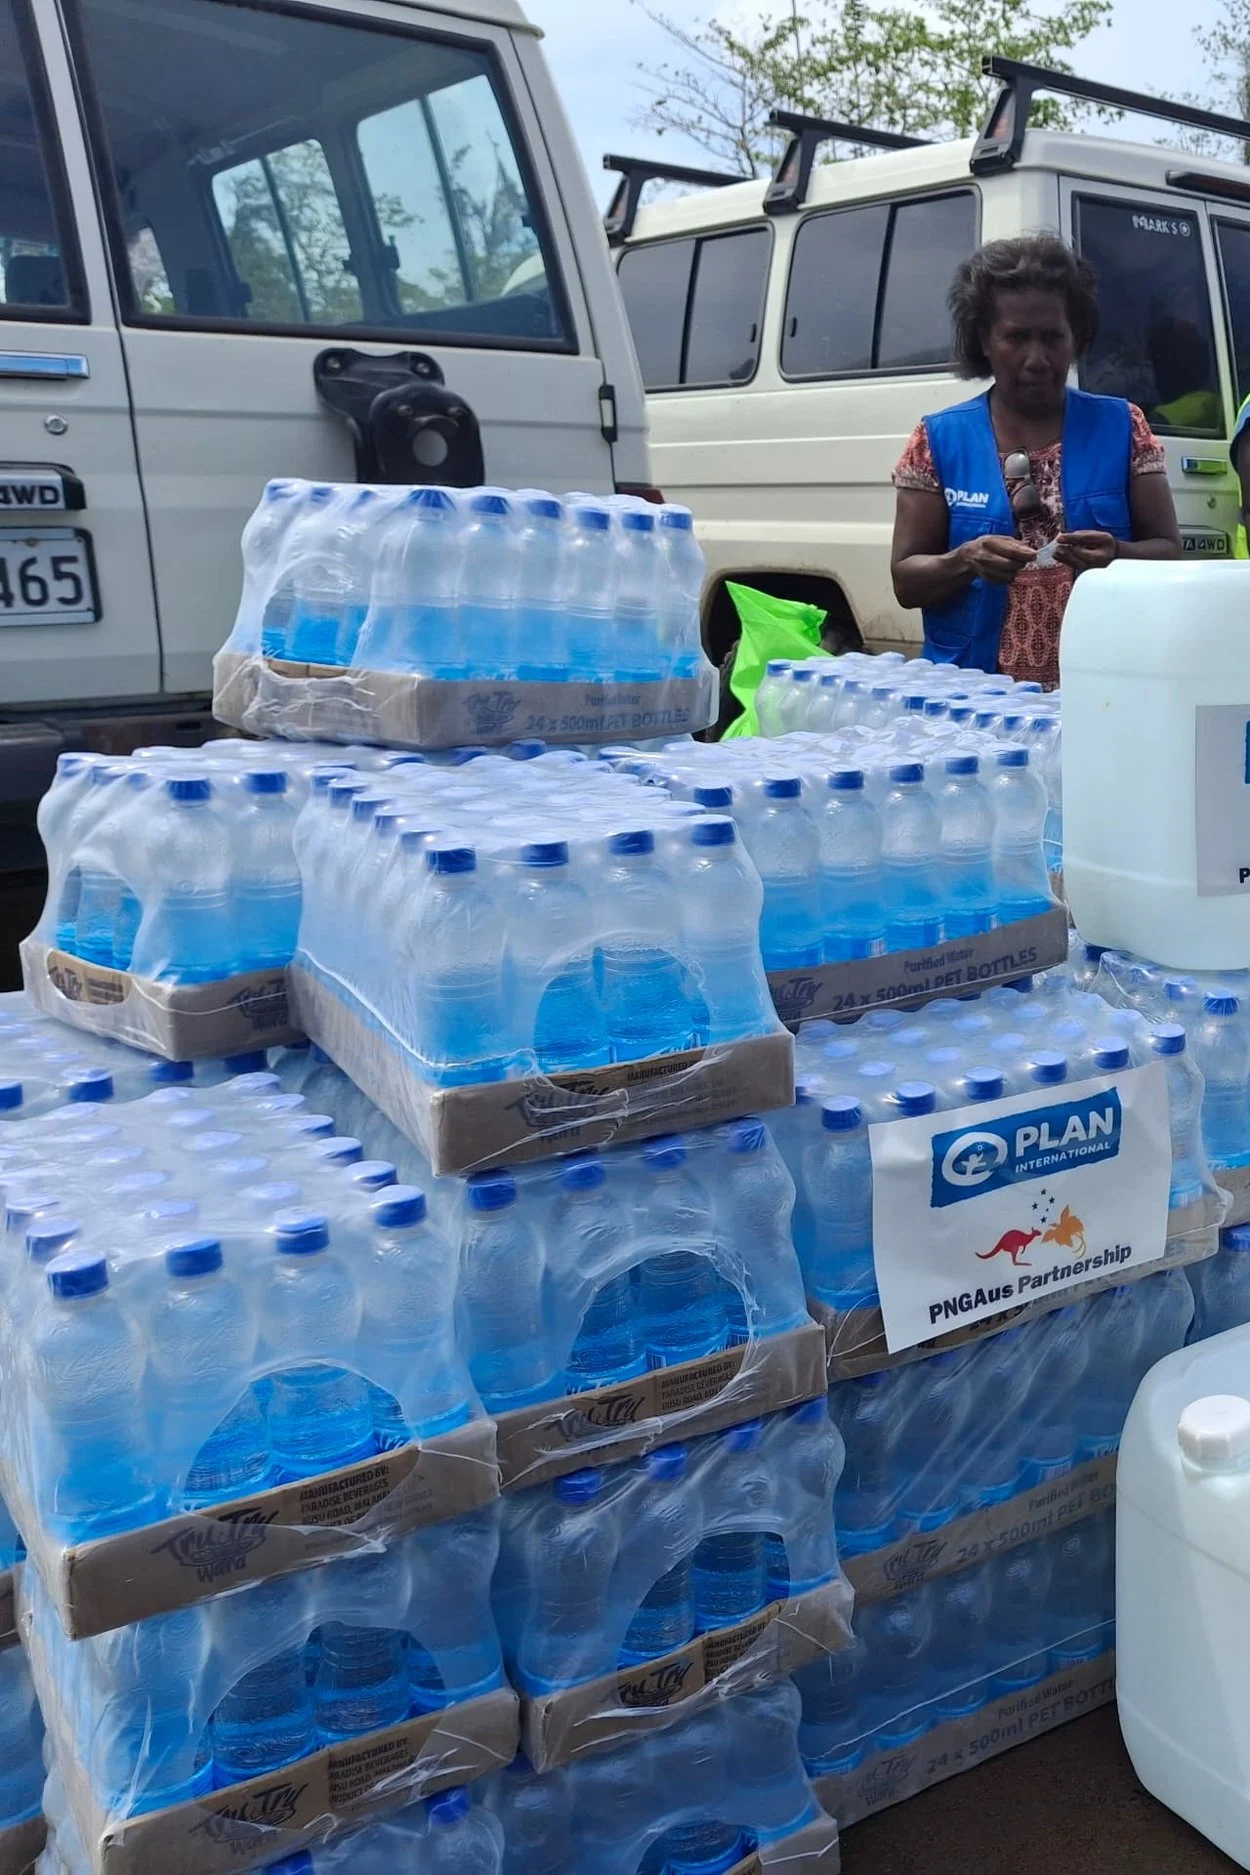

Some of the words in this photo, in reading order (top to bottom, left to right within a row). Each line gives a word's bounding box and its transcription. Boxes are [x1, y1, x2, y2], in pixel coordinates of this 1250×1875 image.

[957, 490, 989, 503] PLAN
[833, 993, 857, 1012] 24
[876, 980, 930, 1002] 500ml
[934, 970, 962, 989] PET
[967, 946, 1038, 980] BOTTLES
[904, 956, 945, 974] Purified
[1015, 1107, 1114, 1157] PLAN
[1015, 1142, 1111, 1174] INTERNATIONAL
[929, 1283, 1014, 1324] PNGAus
[1018, 1244, 1132, 1294] Partnership
[661, 1363, 722, 1389] MANUFACTURED
[300, 1471, 375, 1500] MANUFACTURED
[344, 1478, 389, 1502] BEVERAGES
[970, 1720, 1024, 1756] 500ml
[1028, 1702, 1059, 1729] PET
